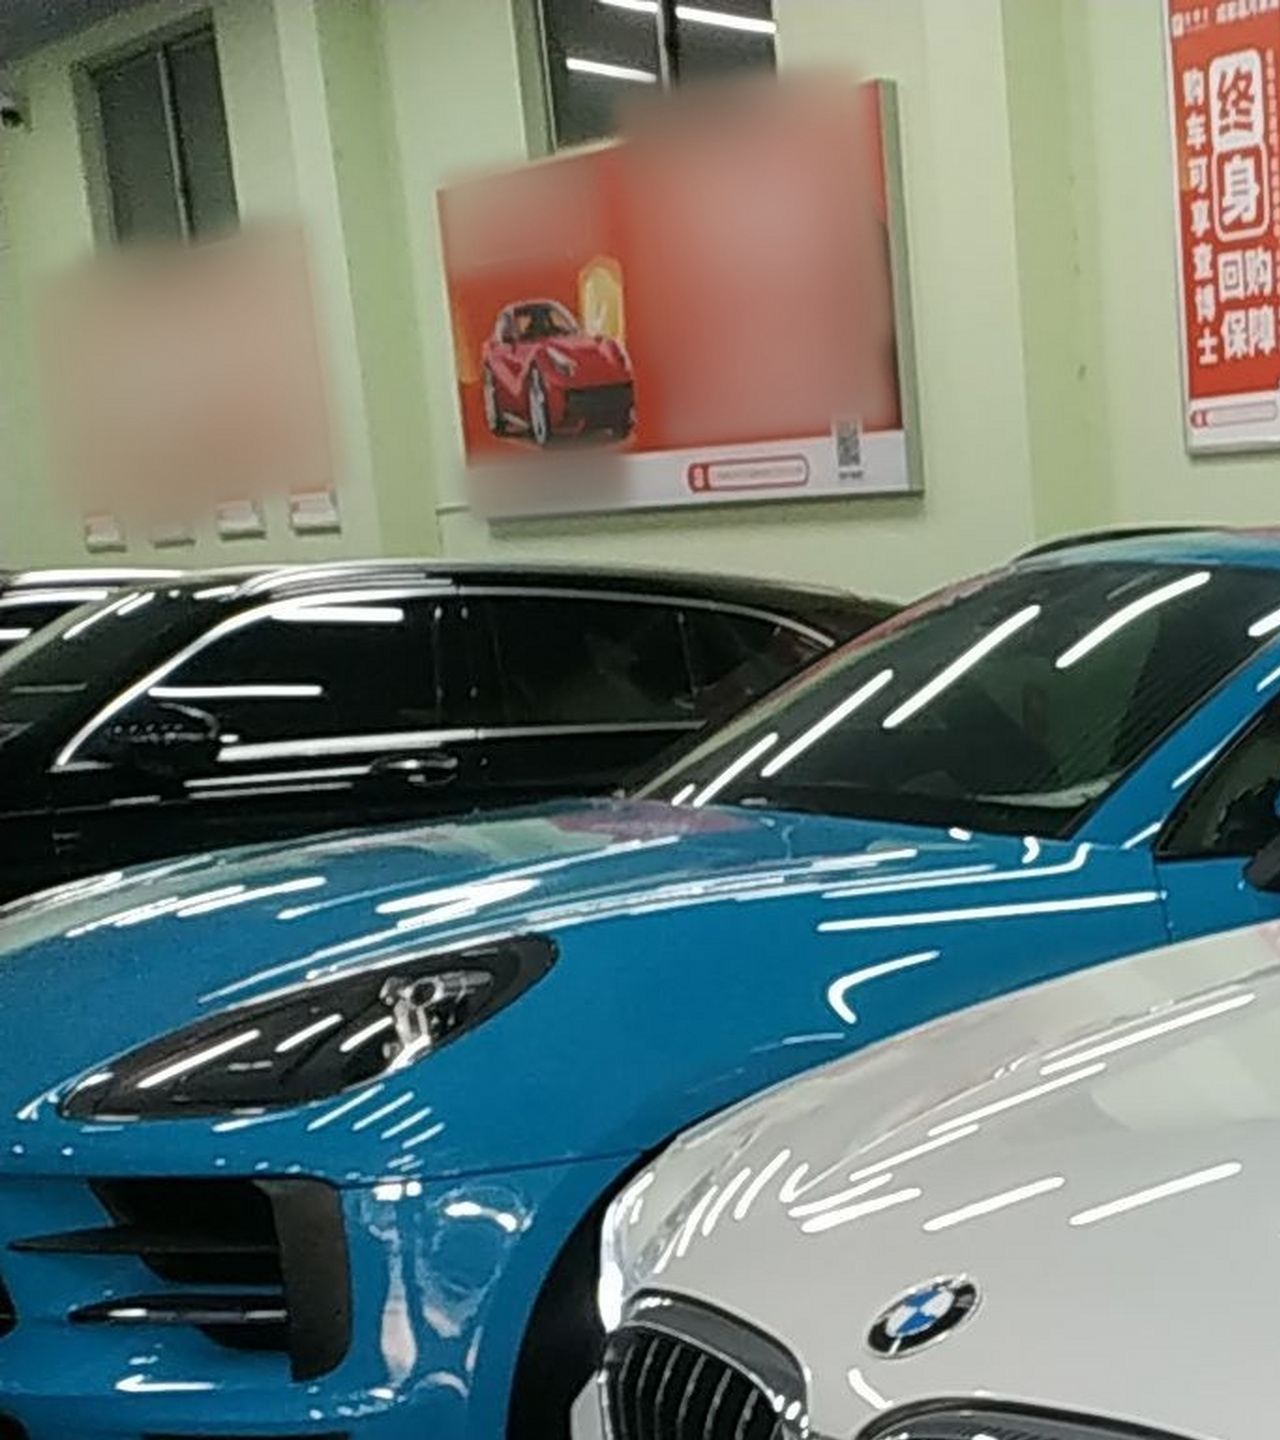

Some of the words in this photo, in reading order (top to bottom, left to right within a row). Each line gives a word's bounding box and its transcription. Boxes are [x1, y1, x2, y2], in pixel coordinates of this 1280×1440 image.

[1217, 66, 1261, 225] 终身
[1217, 246, 1273, 302] 回购
[1221, 305, 1276, 360] 保障
